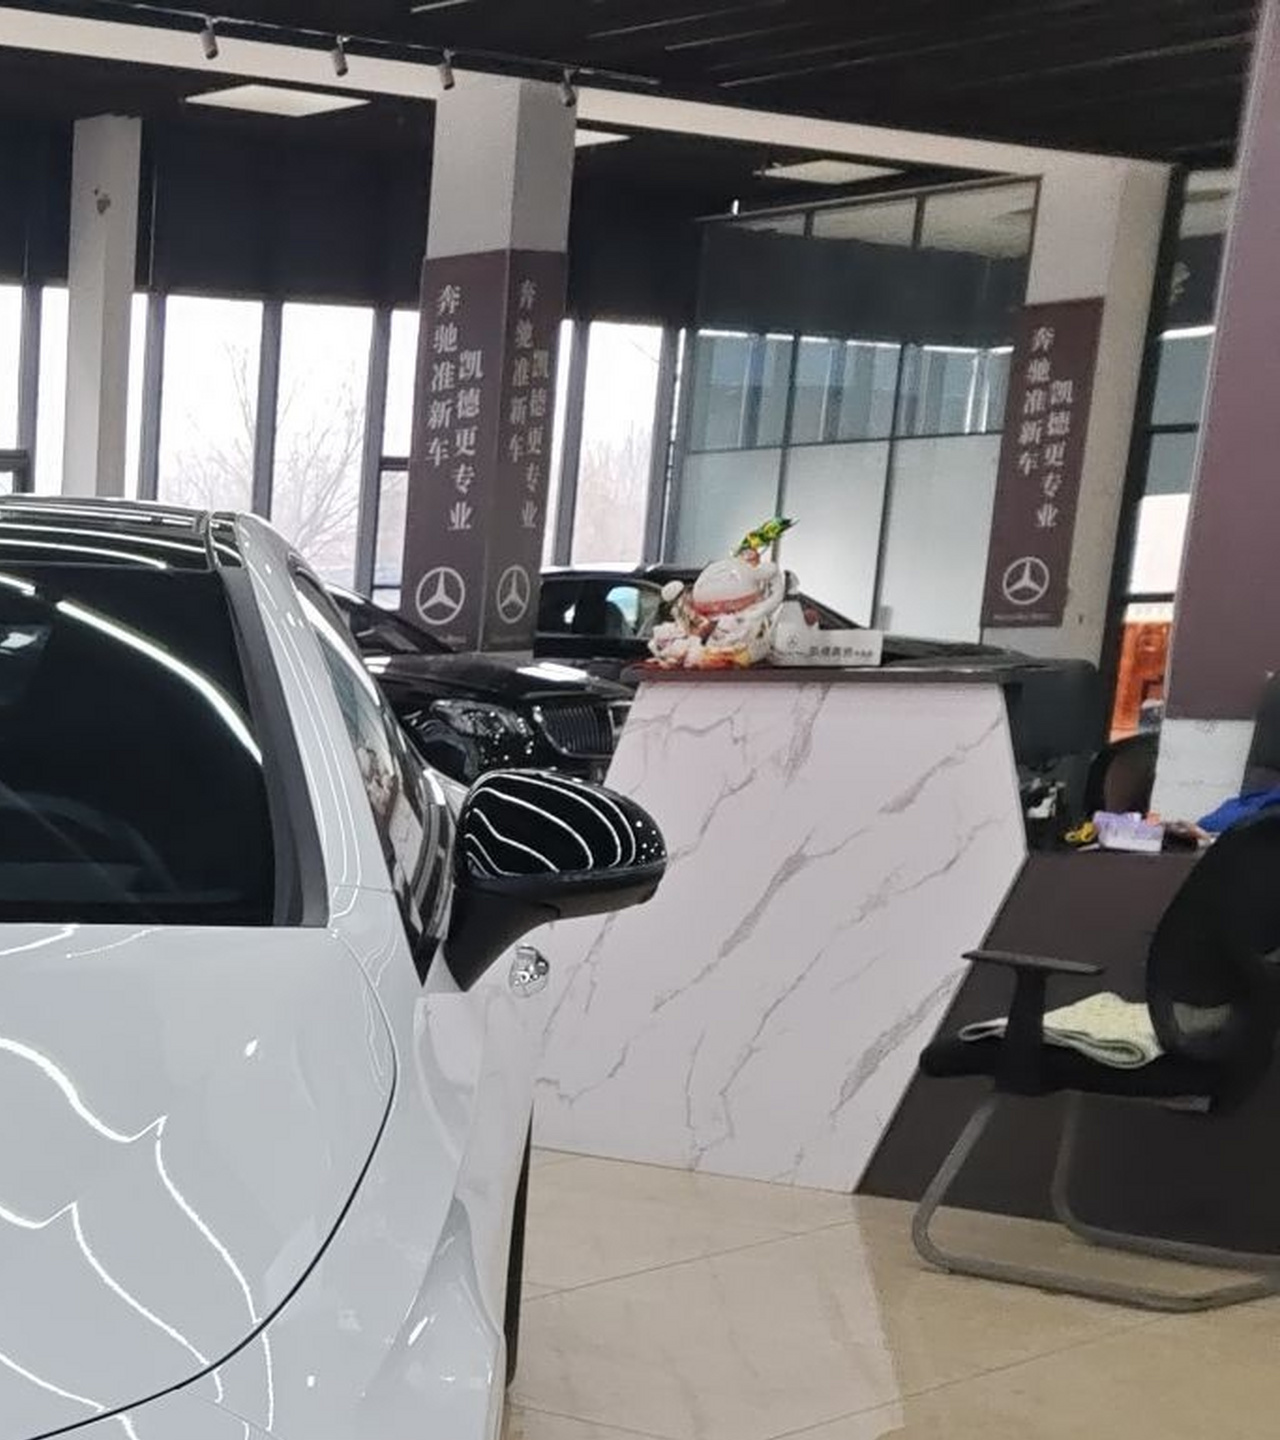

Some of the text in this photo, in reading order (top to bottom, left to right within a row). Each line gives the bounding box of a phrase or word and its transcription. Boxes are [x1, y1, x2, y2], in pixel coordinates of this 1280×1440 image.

[425, 284, 461, 467] 奔驰准新车
[447, 349, 484, 531] 凯德更专业
[1017, 326, 1055, 476] 奔驰准新车
[1035, 379, 1073, 529] 凯德更专业
